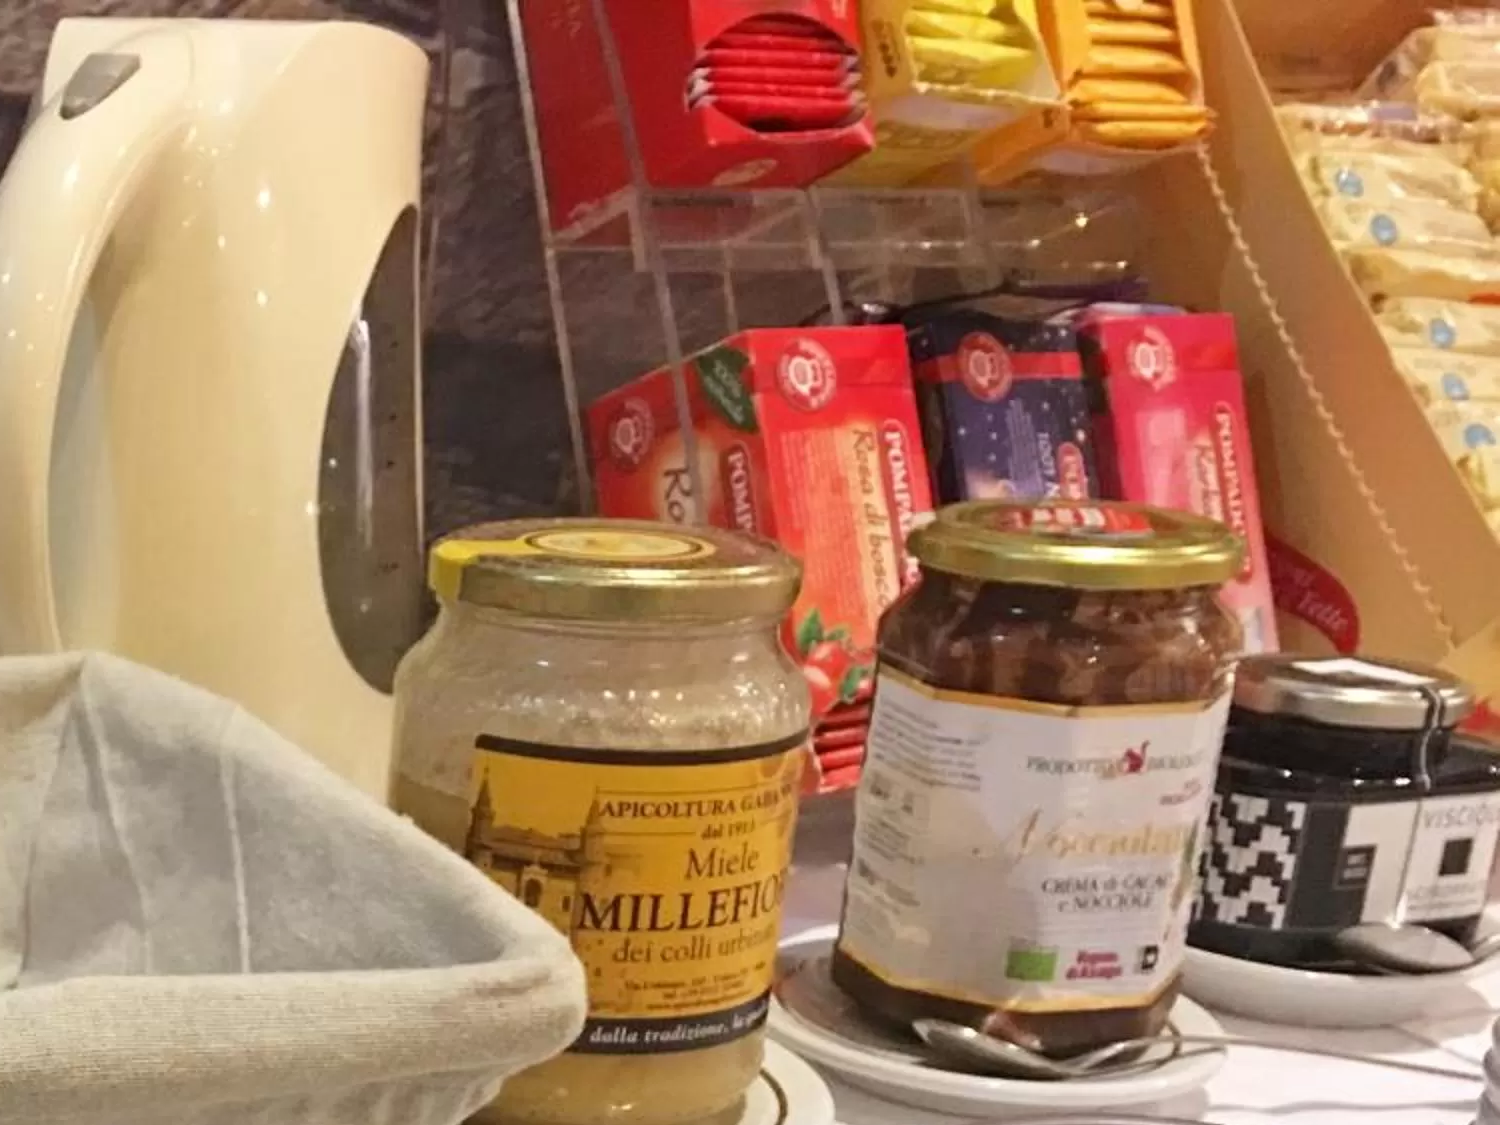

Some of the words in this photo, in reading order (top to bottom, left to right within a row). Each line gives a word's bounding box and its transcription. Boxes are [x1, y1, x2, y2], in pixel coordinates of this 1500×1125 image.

[600, 799, 736, 819] APICOLTURA
[685, 840, 760, 881] Miele
[611, 936, 653, 964] dei
[660, 934, 712, 964] colli
